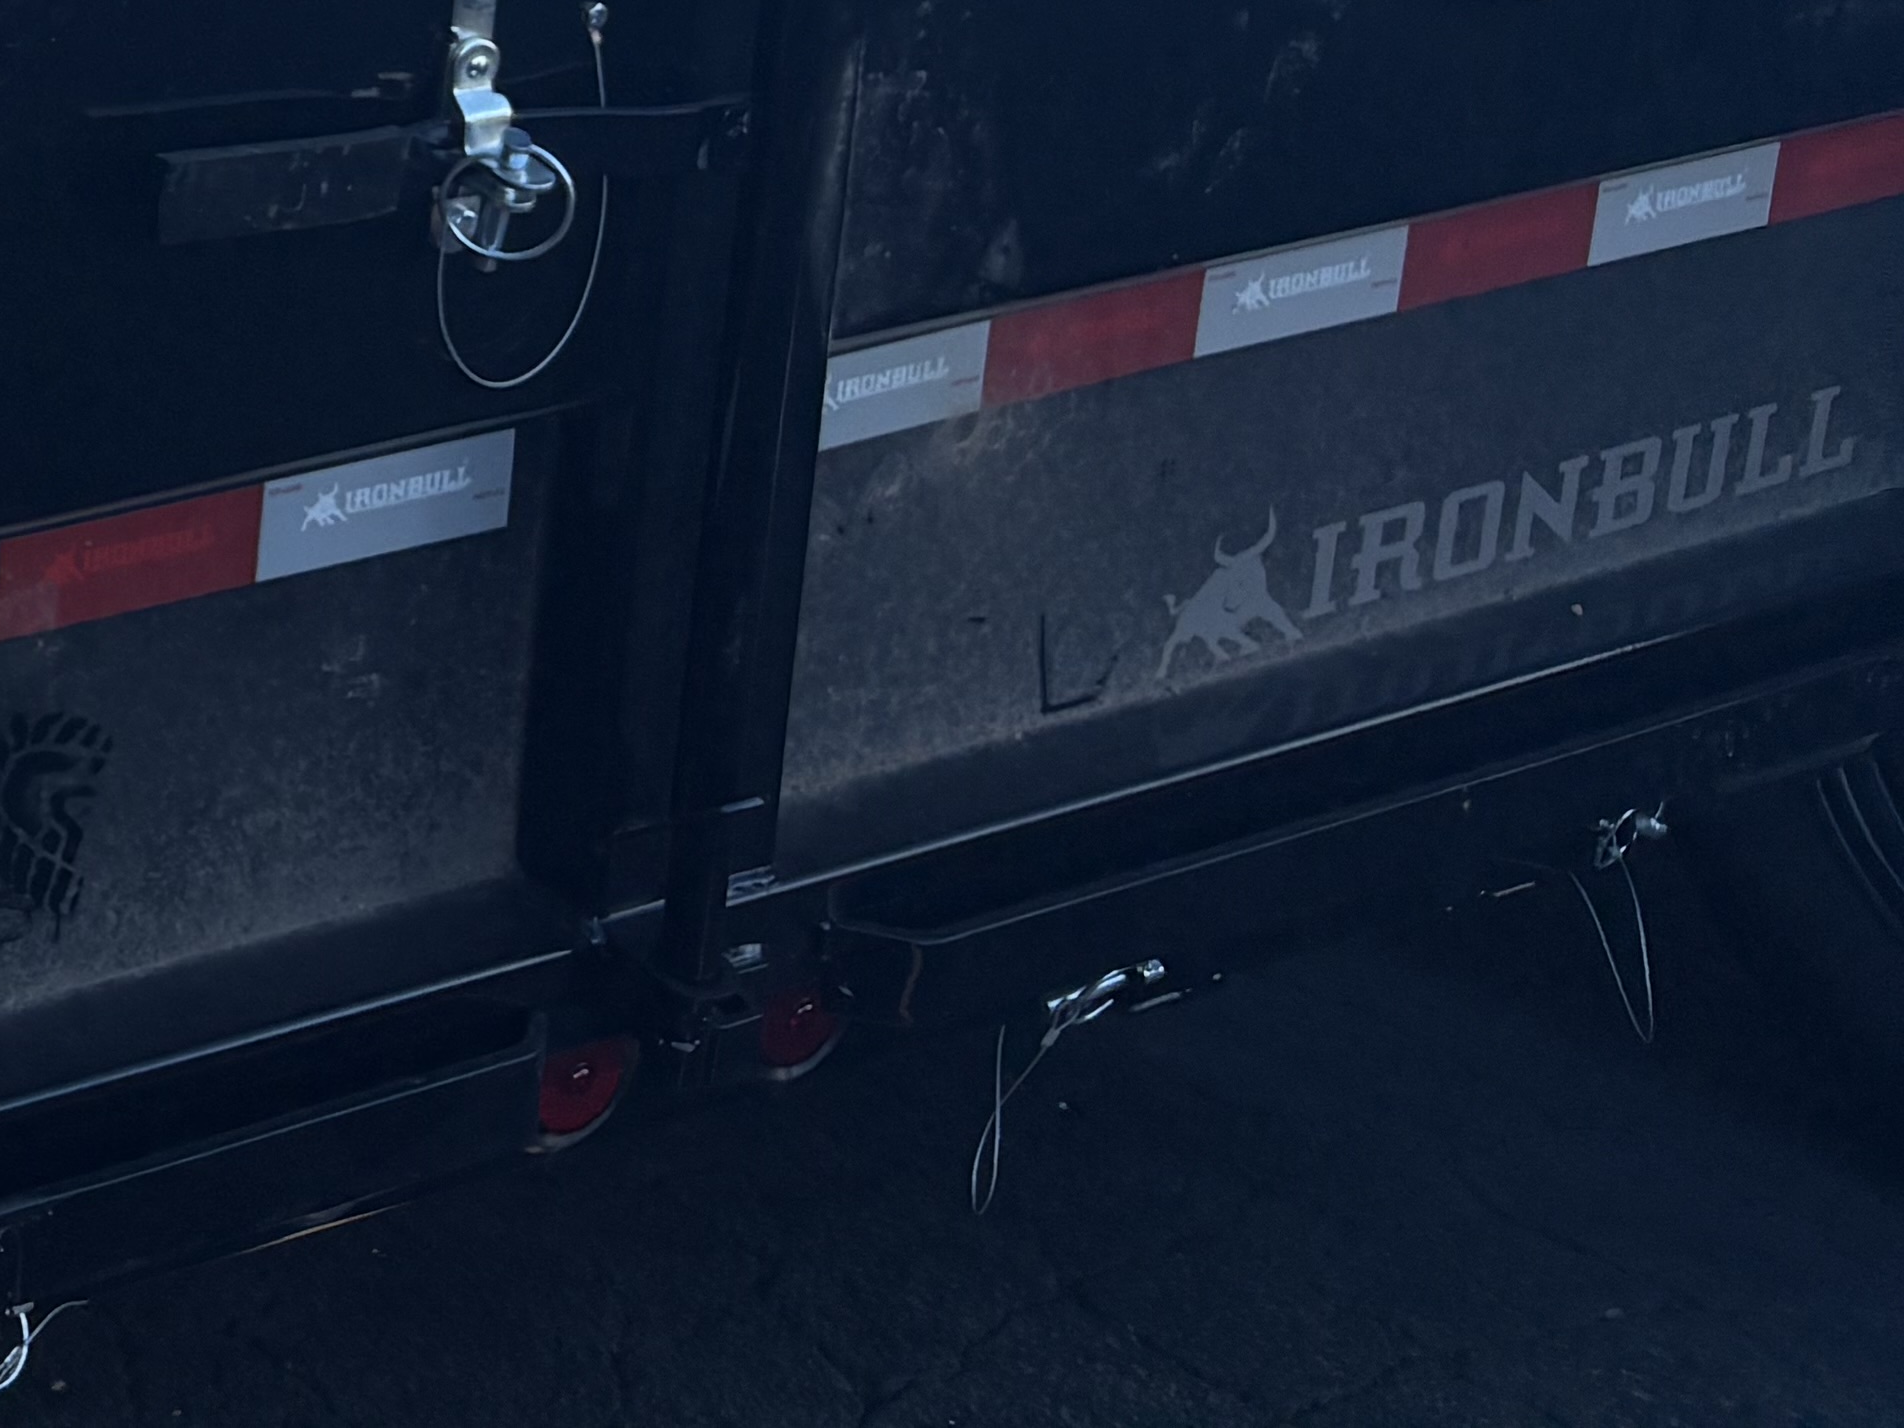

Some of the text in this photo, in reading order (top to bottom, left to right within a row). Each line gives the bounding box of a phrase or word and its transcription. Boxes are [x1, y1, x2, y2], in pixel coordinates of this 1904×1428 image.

[1268, 255, 1372, 299] IRONBULL
[835, 356, 950, 404] IRONBULL
[345, 465, 473, 514] IRONBULL
[1298, 385, 1856, 621] IRONBULL
